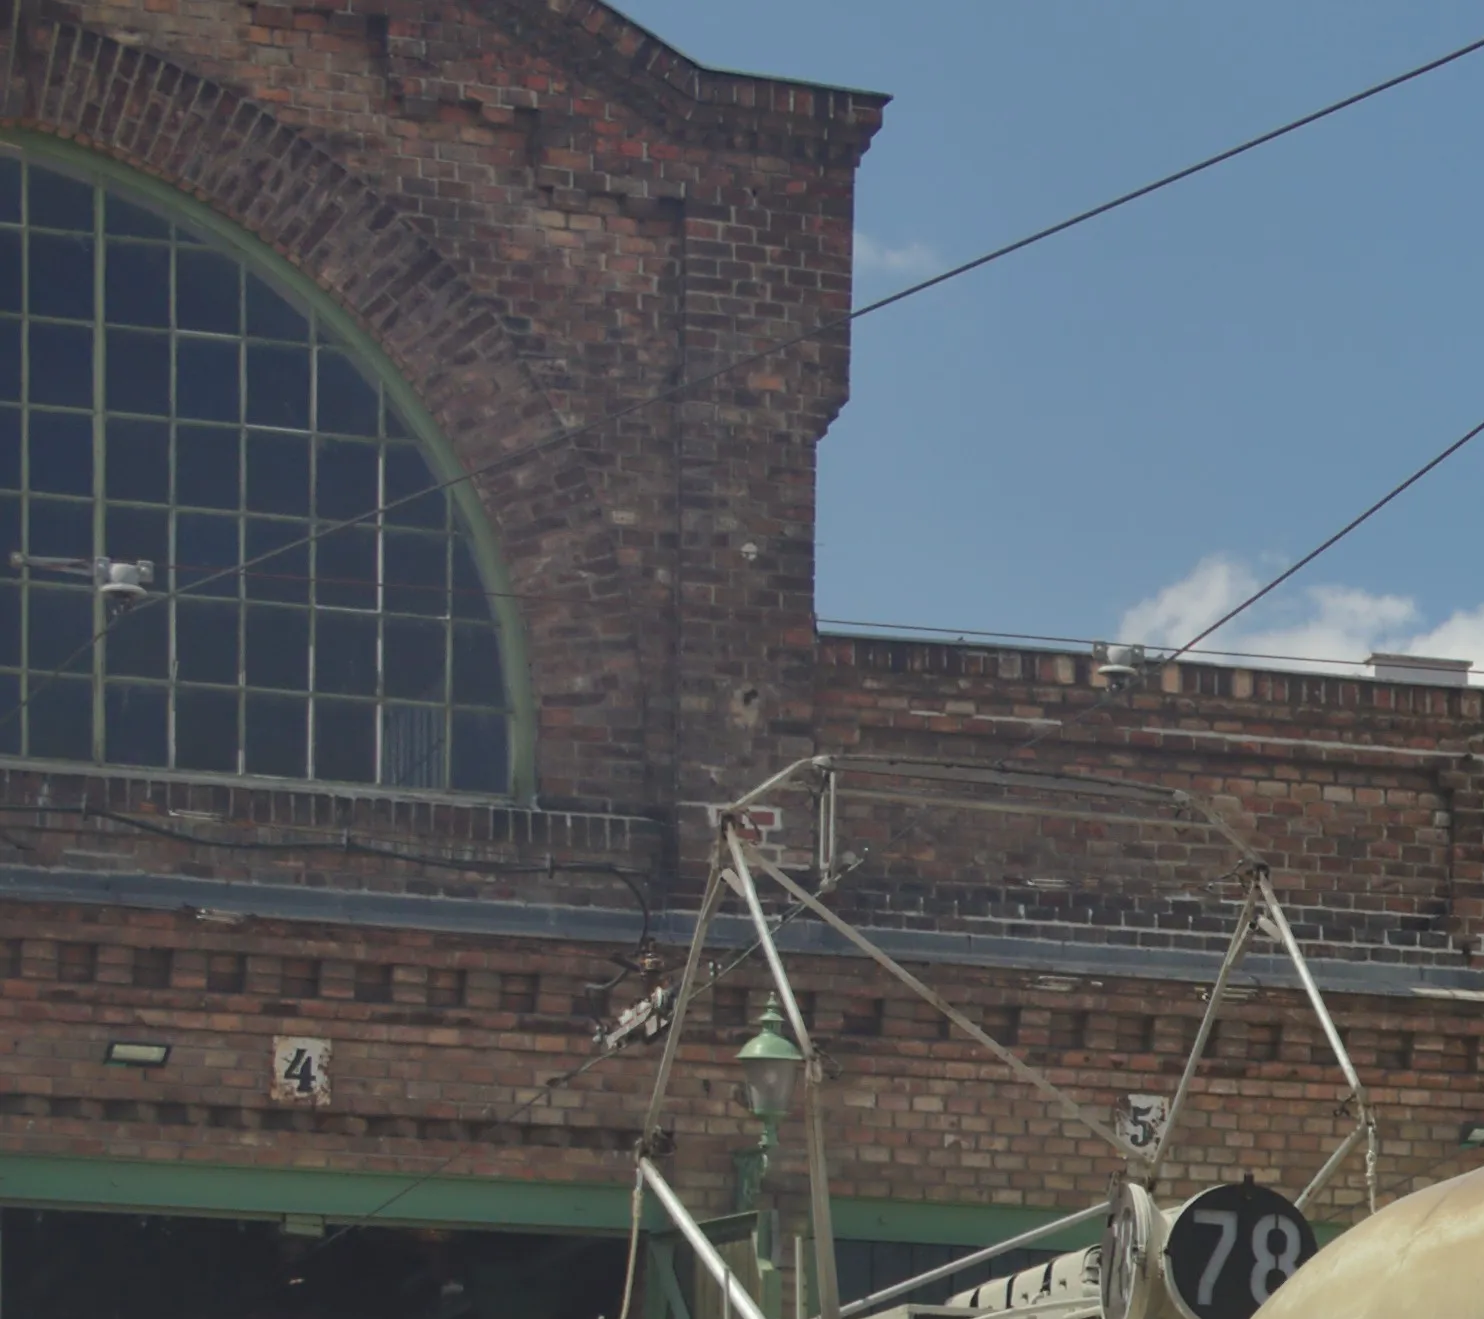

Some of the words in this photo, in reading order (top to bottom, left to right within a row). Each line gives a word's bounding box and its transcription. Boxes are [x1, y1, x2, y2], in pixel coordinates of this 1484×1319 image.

[283, 1047, 317, 1093] 4
[1129, 1106, 1155, 1148] 5
[1193, 1209, 1301, 1306] 78
